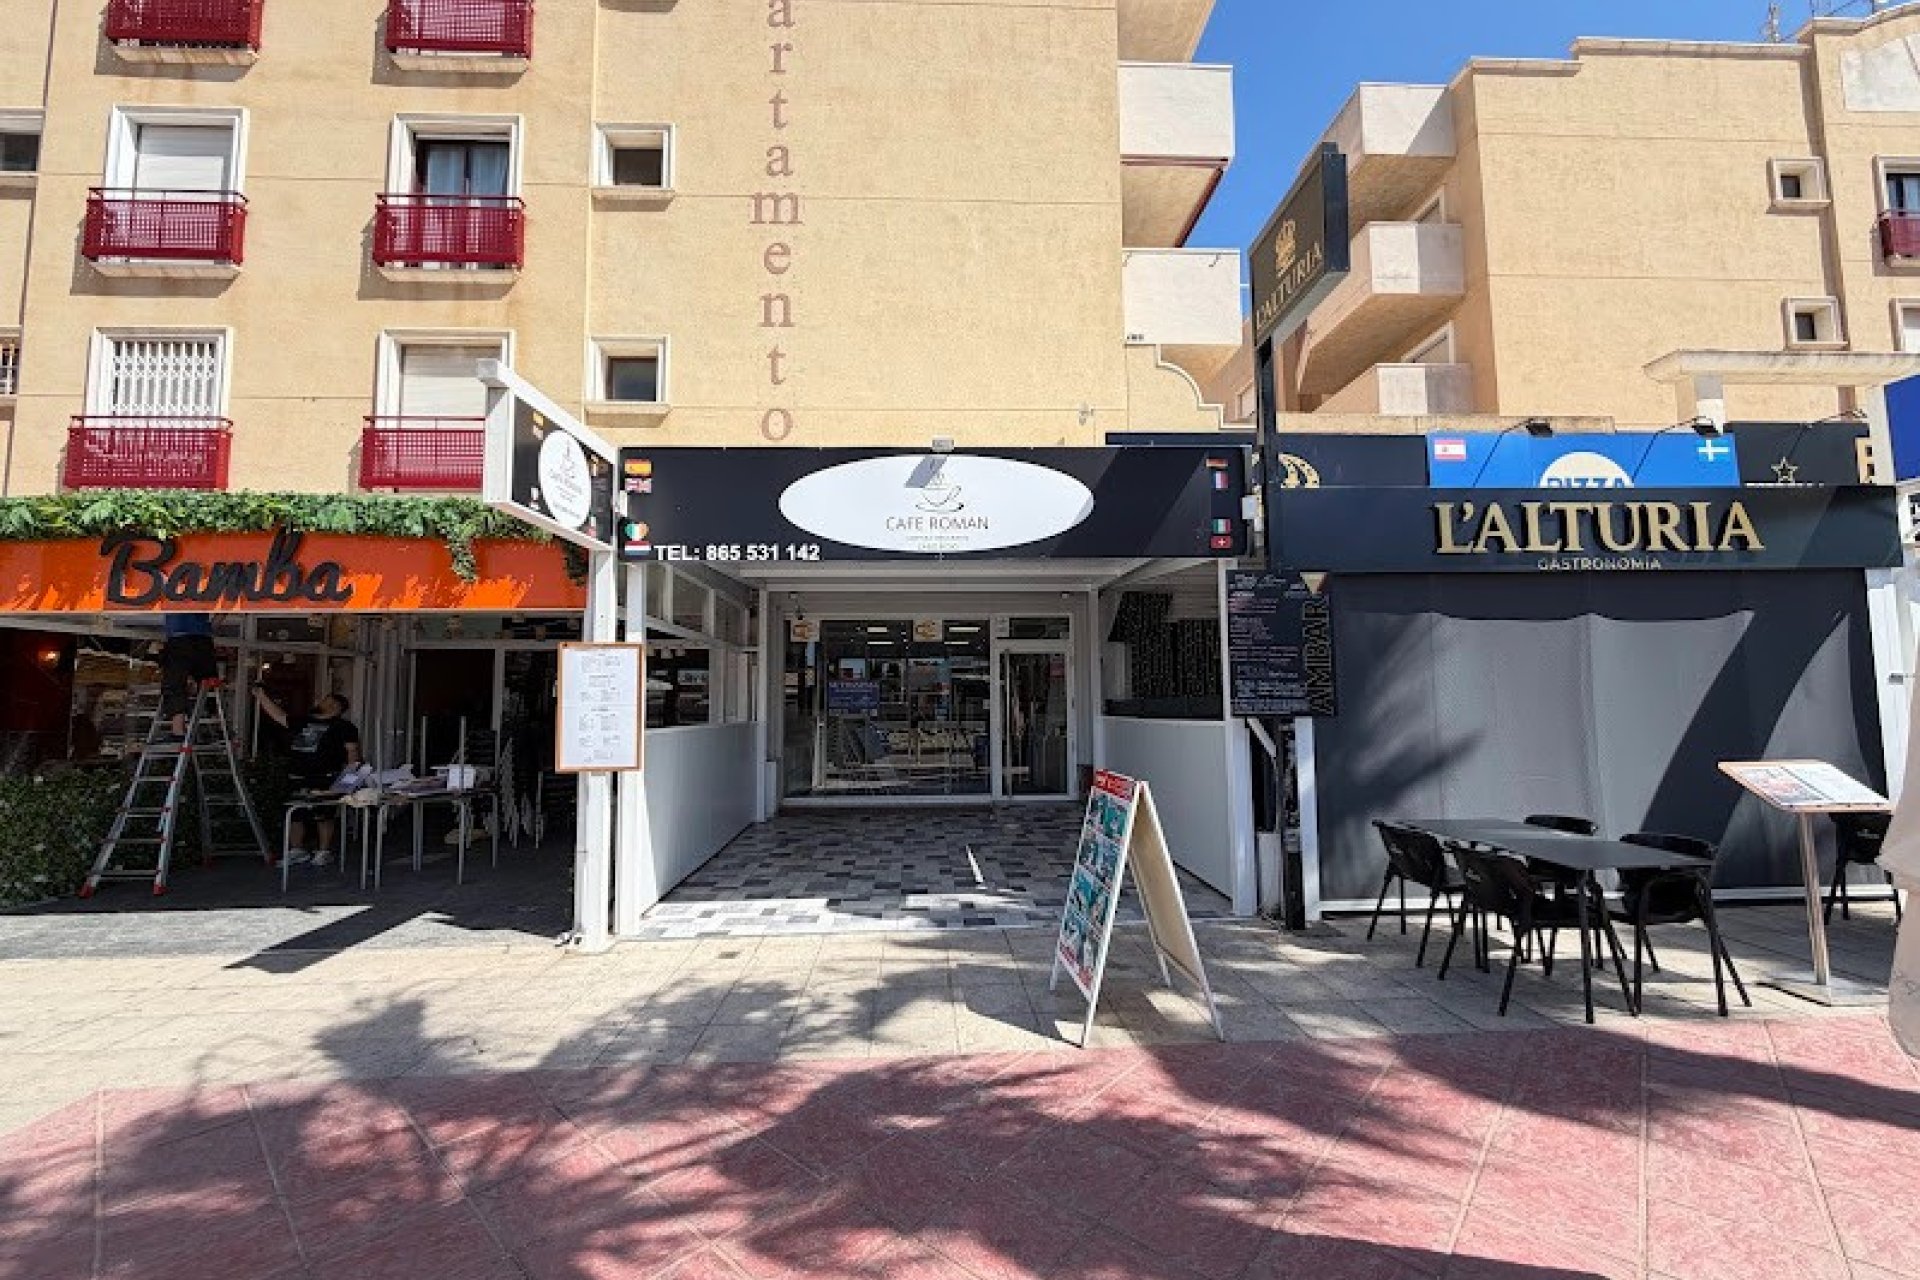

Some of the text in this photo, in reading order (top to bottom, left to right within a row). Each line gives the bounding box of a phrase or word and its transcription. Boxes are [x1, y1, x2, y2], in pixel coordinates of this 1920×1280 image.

[886, 515, 990, 532] CAFE ROMAN
[653, 543, 821, 561] TEL: 865 531 142
[99, 524, 354, 607] Bamba
